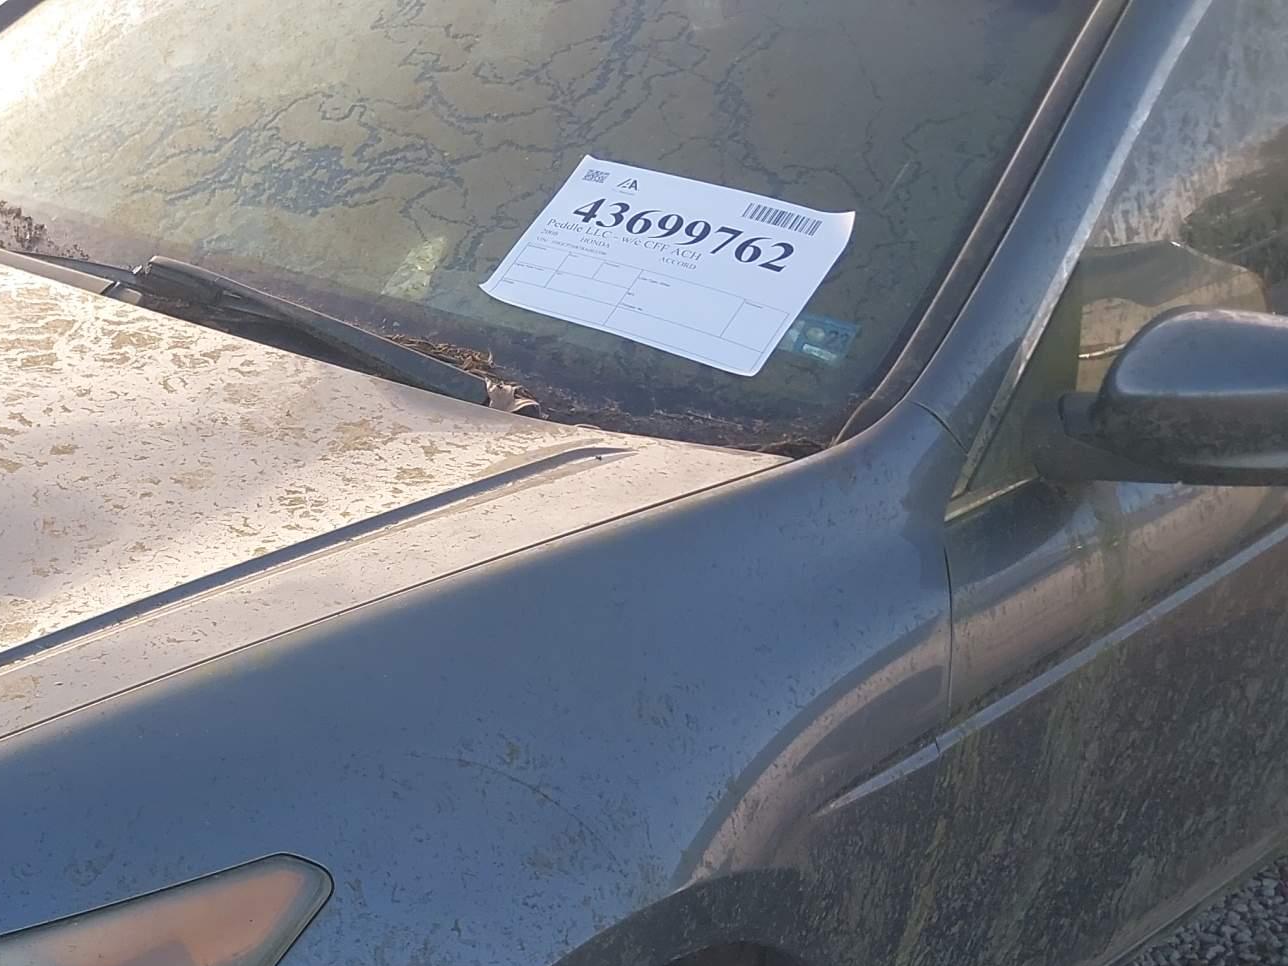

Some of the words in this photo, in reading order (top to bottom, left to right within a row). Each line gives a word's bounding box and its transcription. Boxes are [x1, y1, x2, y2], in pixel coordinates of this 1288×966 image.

[547, 218, 584, 233] Peddle
[585, 225, 613, 239] LLC
[670, 247, 703, 262] ACH
[572, 197, 795, 273] 43699762
[579, 236, 611, 249] HONDA
[659, 256, 697, 271] ACCORD
